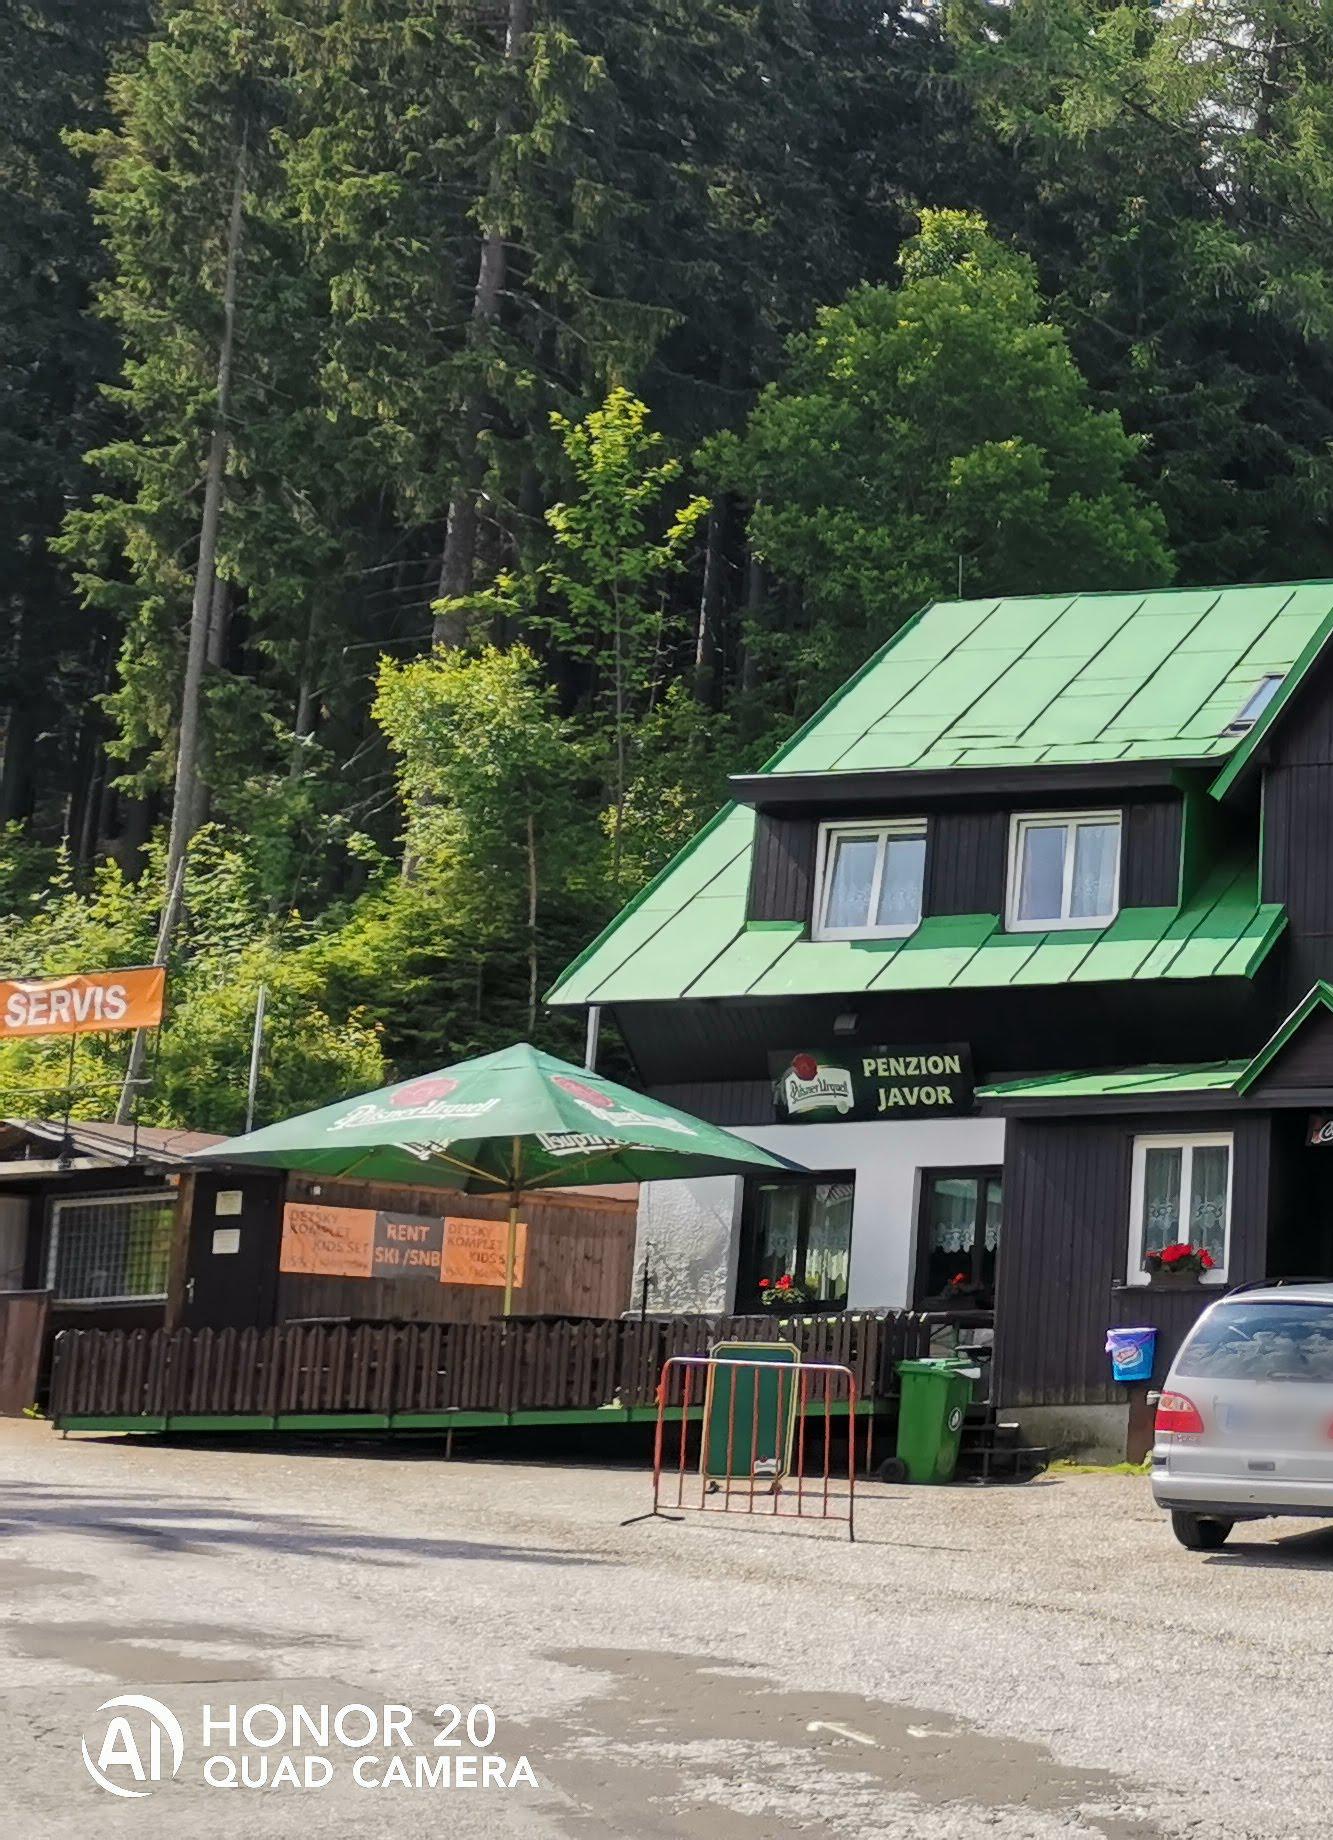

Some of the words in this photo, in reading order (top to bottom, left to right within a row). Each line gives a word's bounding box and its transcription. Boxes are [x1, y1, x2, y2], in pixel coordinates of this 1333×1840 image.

[4, 984, 127, 1028] SERVIS
[862, 1055, 961, 1077] PENZION
[878, 1086, 953, 1112] JAVOR
[386, 1224, 431, 1242] RENT
[374, 1246, 399, 1264] SKI
[402, 1249, 441, 1267] /SNB
